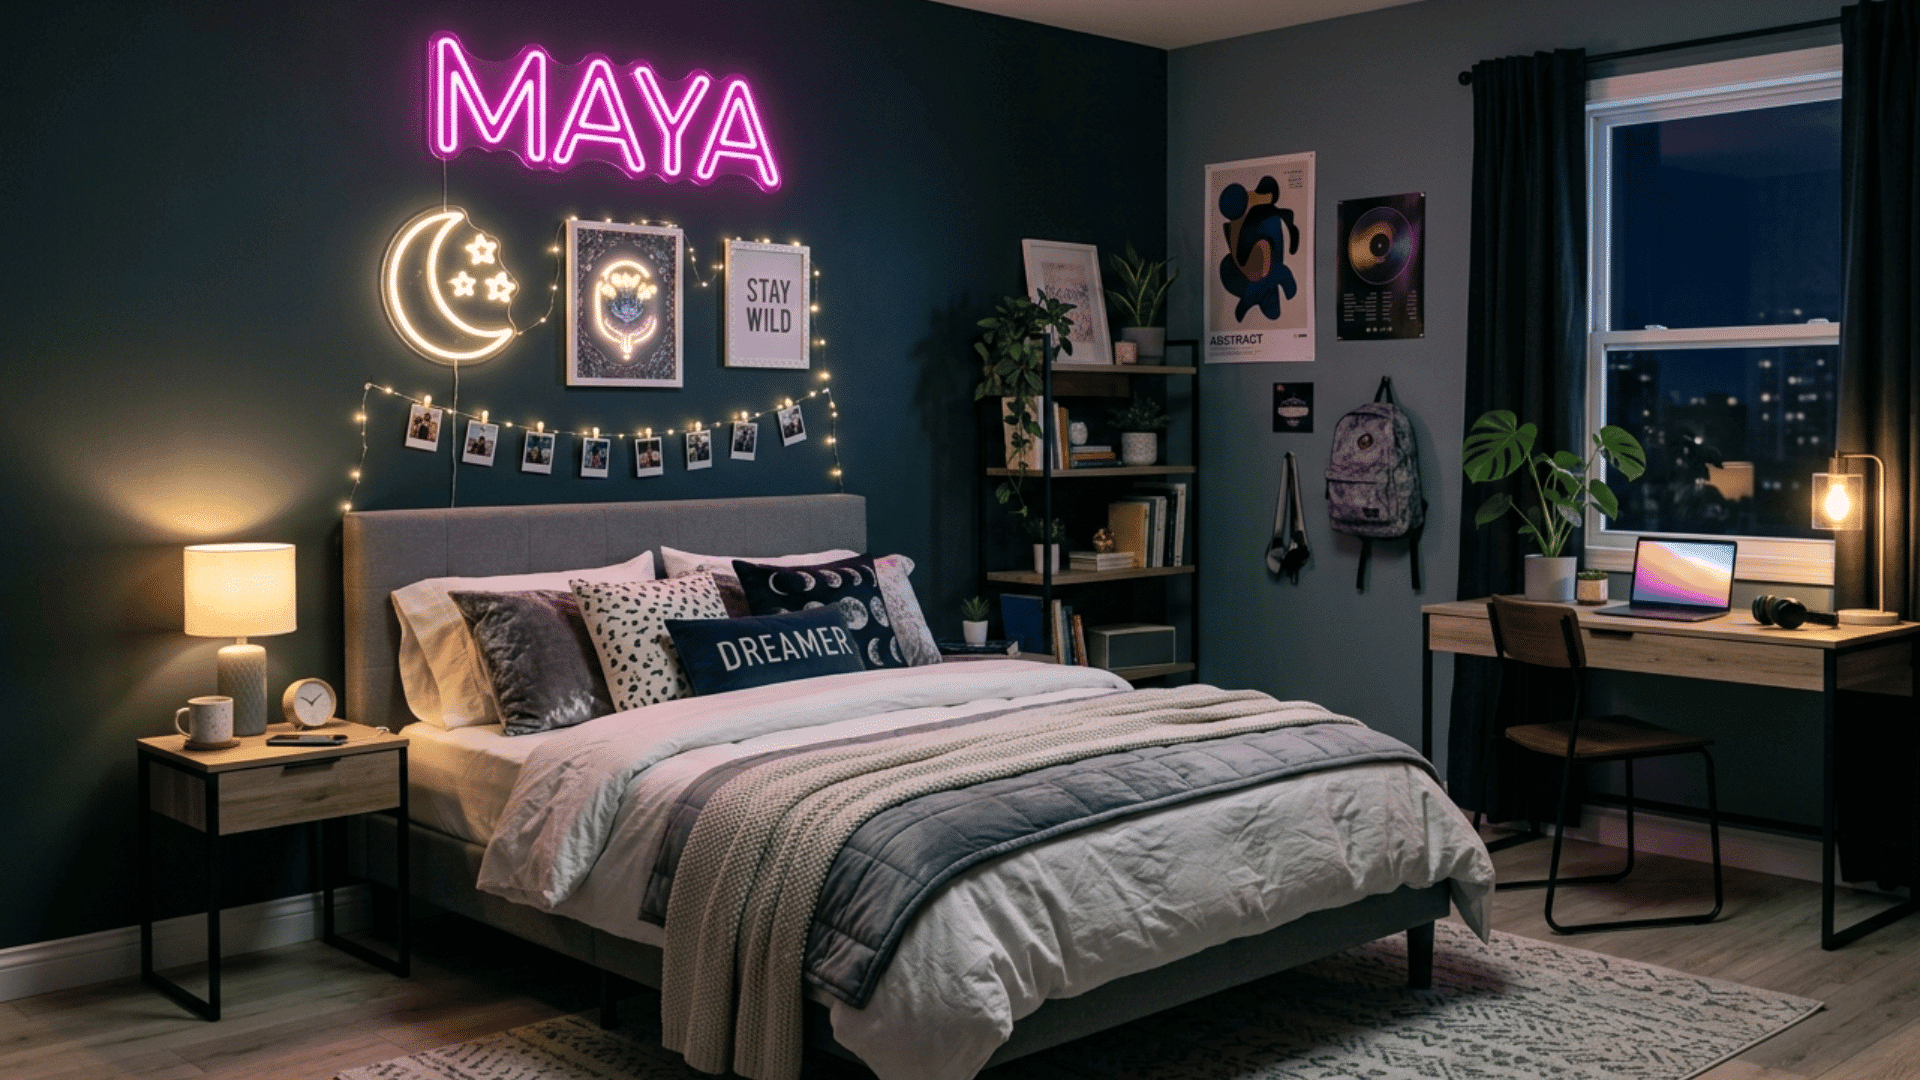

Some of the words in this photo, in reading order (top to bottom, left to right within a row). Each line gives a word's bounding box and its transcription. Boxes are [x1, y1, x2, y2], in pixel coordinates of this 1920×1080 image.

[437, 37, 779, 187] MAYA
[747, 278, 791, 304] STAY
[746, 307, 791, 333] WILD
[1210, 333, 1263, 345] ABSTRACT
[716, 626, 854, 672] DREAMER
